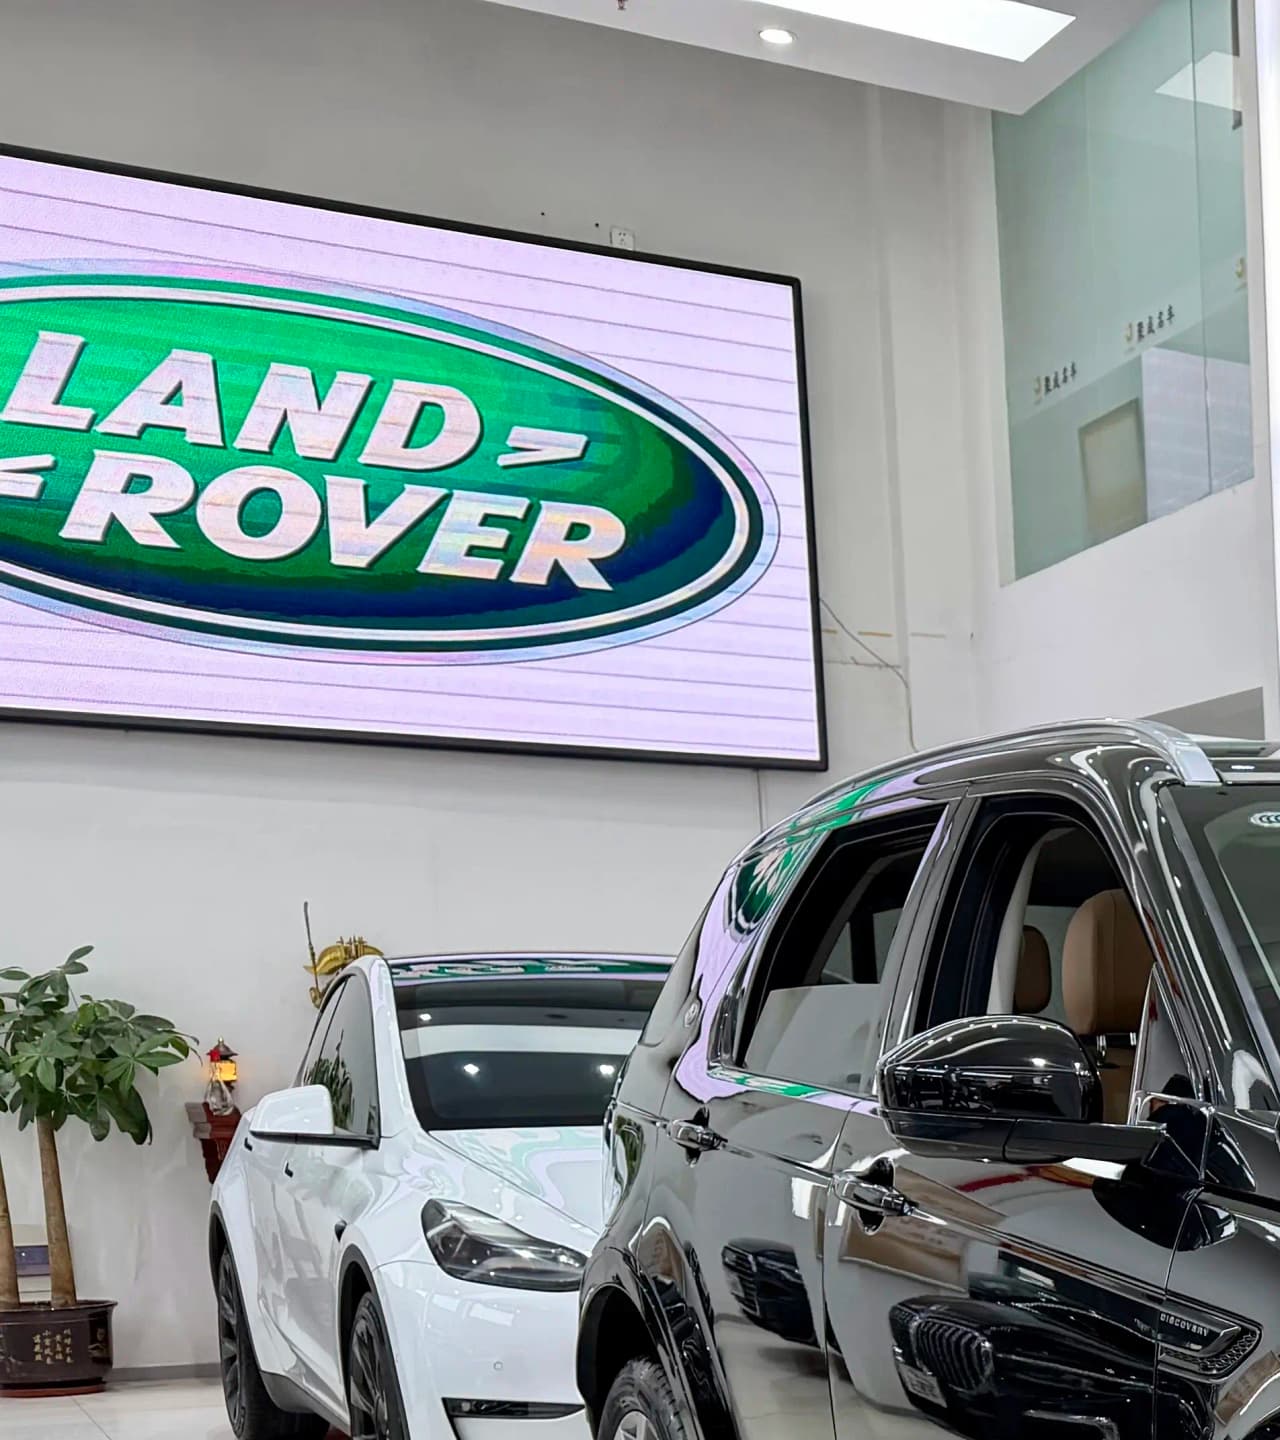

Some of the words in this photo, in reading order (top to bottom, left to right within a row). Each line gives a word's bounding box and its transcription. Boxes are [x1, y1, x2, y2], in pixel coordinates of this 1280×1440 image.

[2, 330, 485, 471] LAND
[58, 451, 627, 592] ROVER
[1160, 1313, 1209, 1337] DISCOVERY
